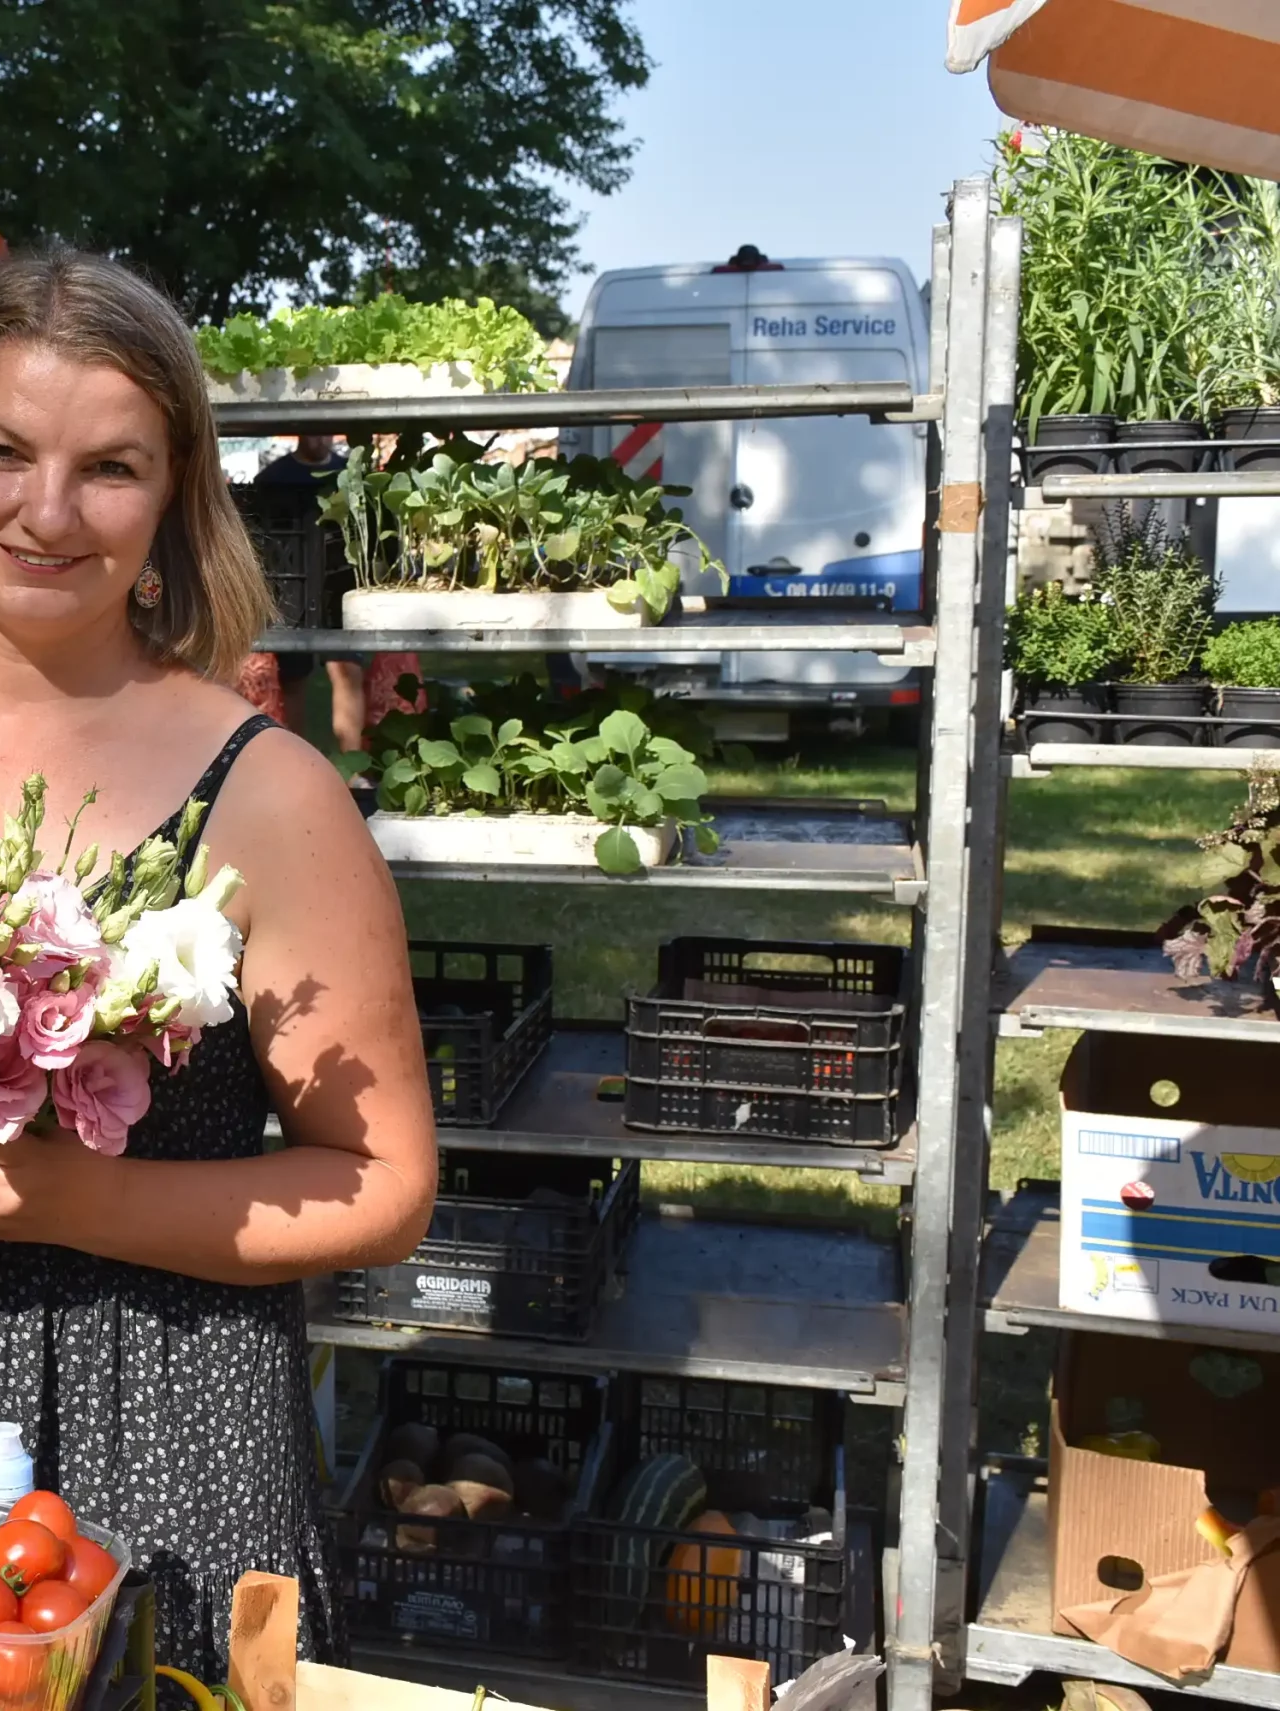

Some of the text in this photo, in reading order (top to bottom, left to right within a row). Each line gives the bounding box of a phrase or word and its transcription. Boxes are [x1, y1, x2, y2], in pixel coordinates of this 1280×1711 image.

[753, 315, 896, 337] Reha Service
[416, 1275, 491, 1294] AGRIDAMA
[1171, 1287, 1229, 1308] PACK
